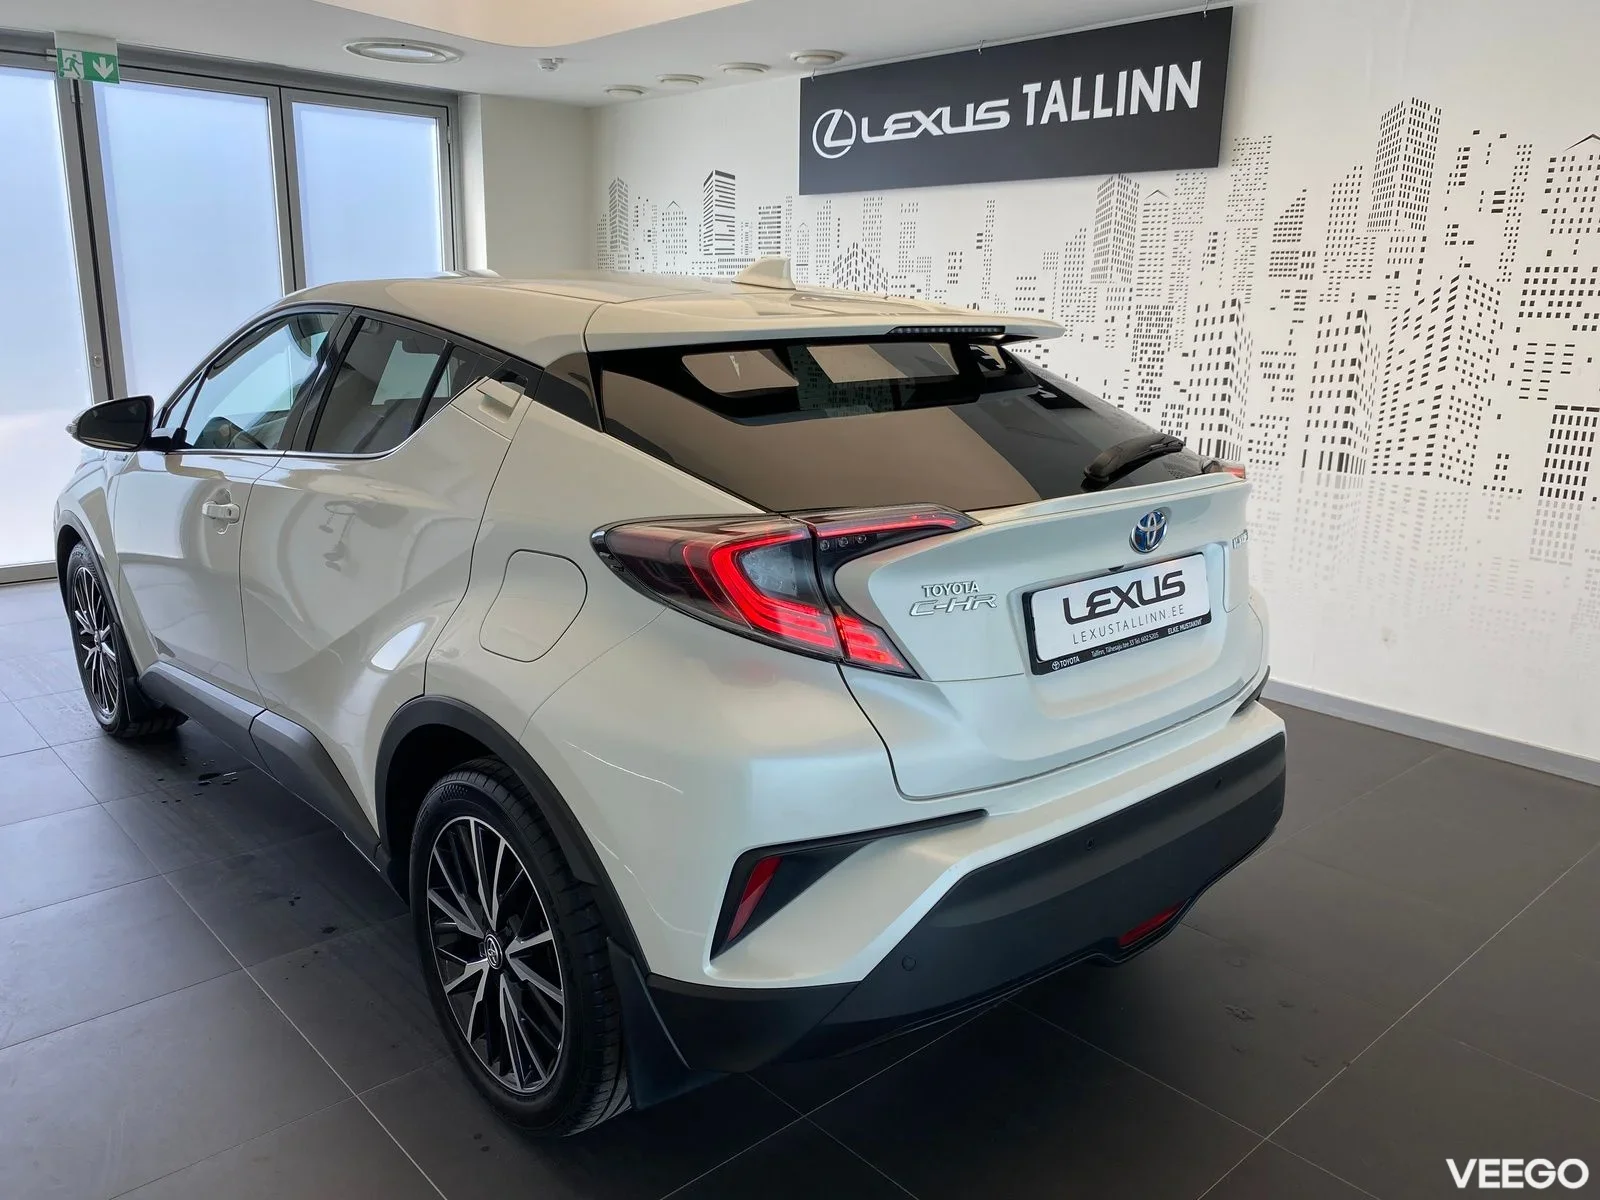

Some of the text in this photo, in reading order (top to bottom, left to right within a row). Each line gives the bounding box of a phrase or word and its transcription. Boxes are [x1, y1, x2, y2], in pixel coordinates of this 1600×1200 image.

[861, 60, 1202, 144] LEXUS TALLINN
[921, 580, 980, 598] TOYOTA
[1062, 570, 1186, 625] LEXUS
[909, 594, 997, 616] C-HR
[1072, 604, 1185, 645] LEXUSTALLINN.EE
[1059, 656, 1081, 668] TOYOTA
